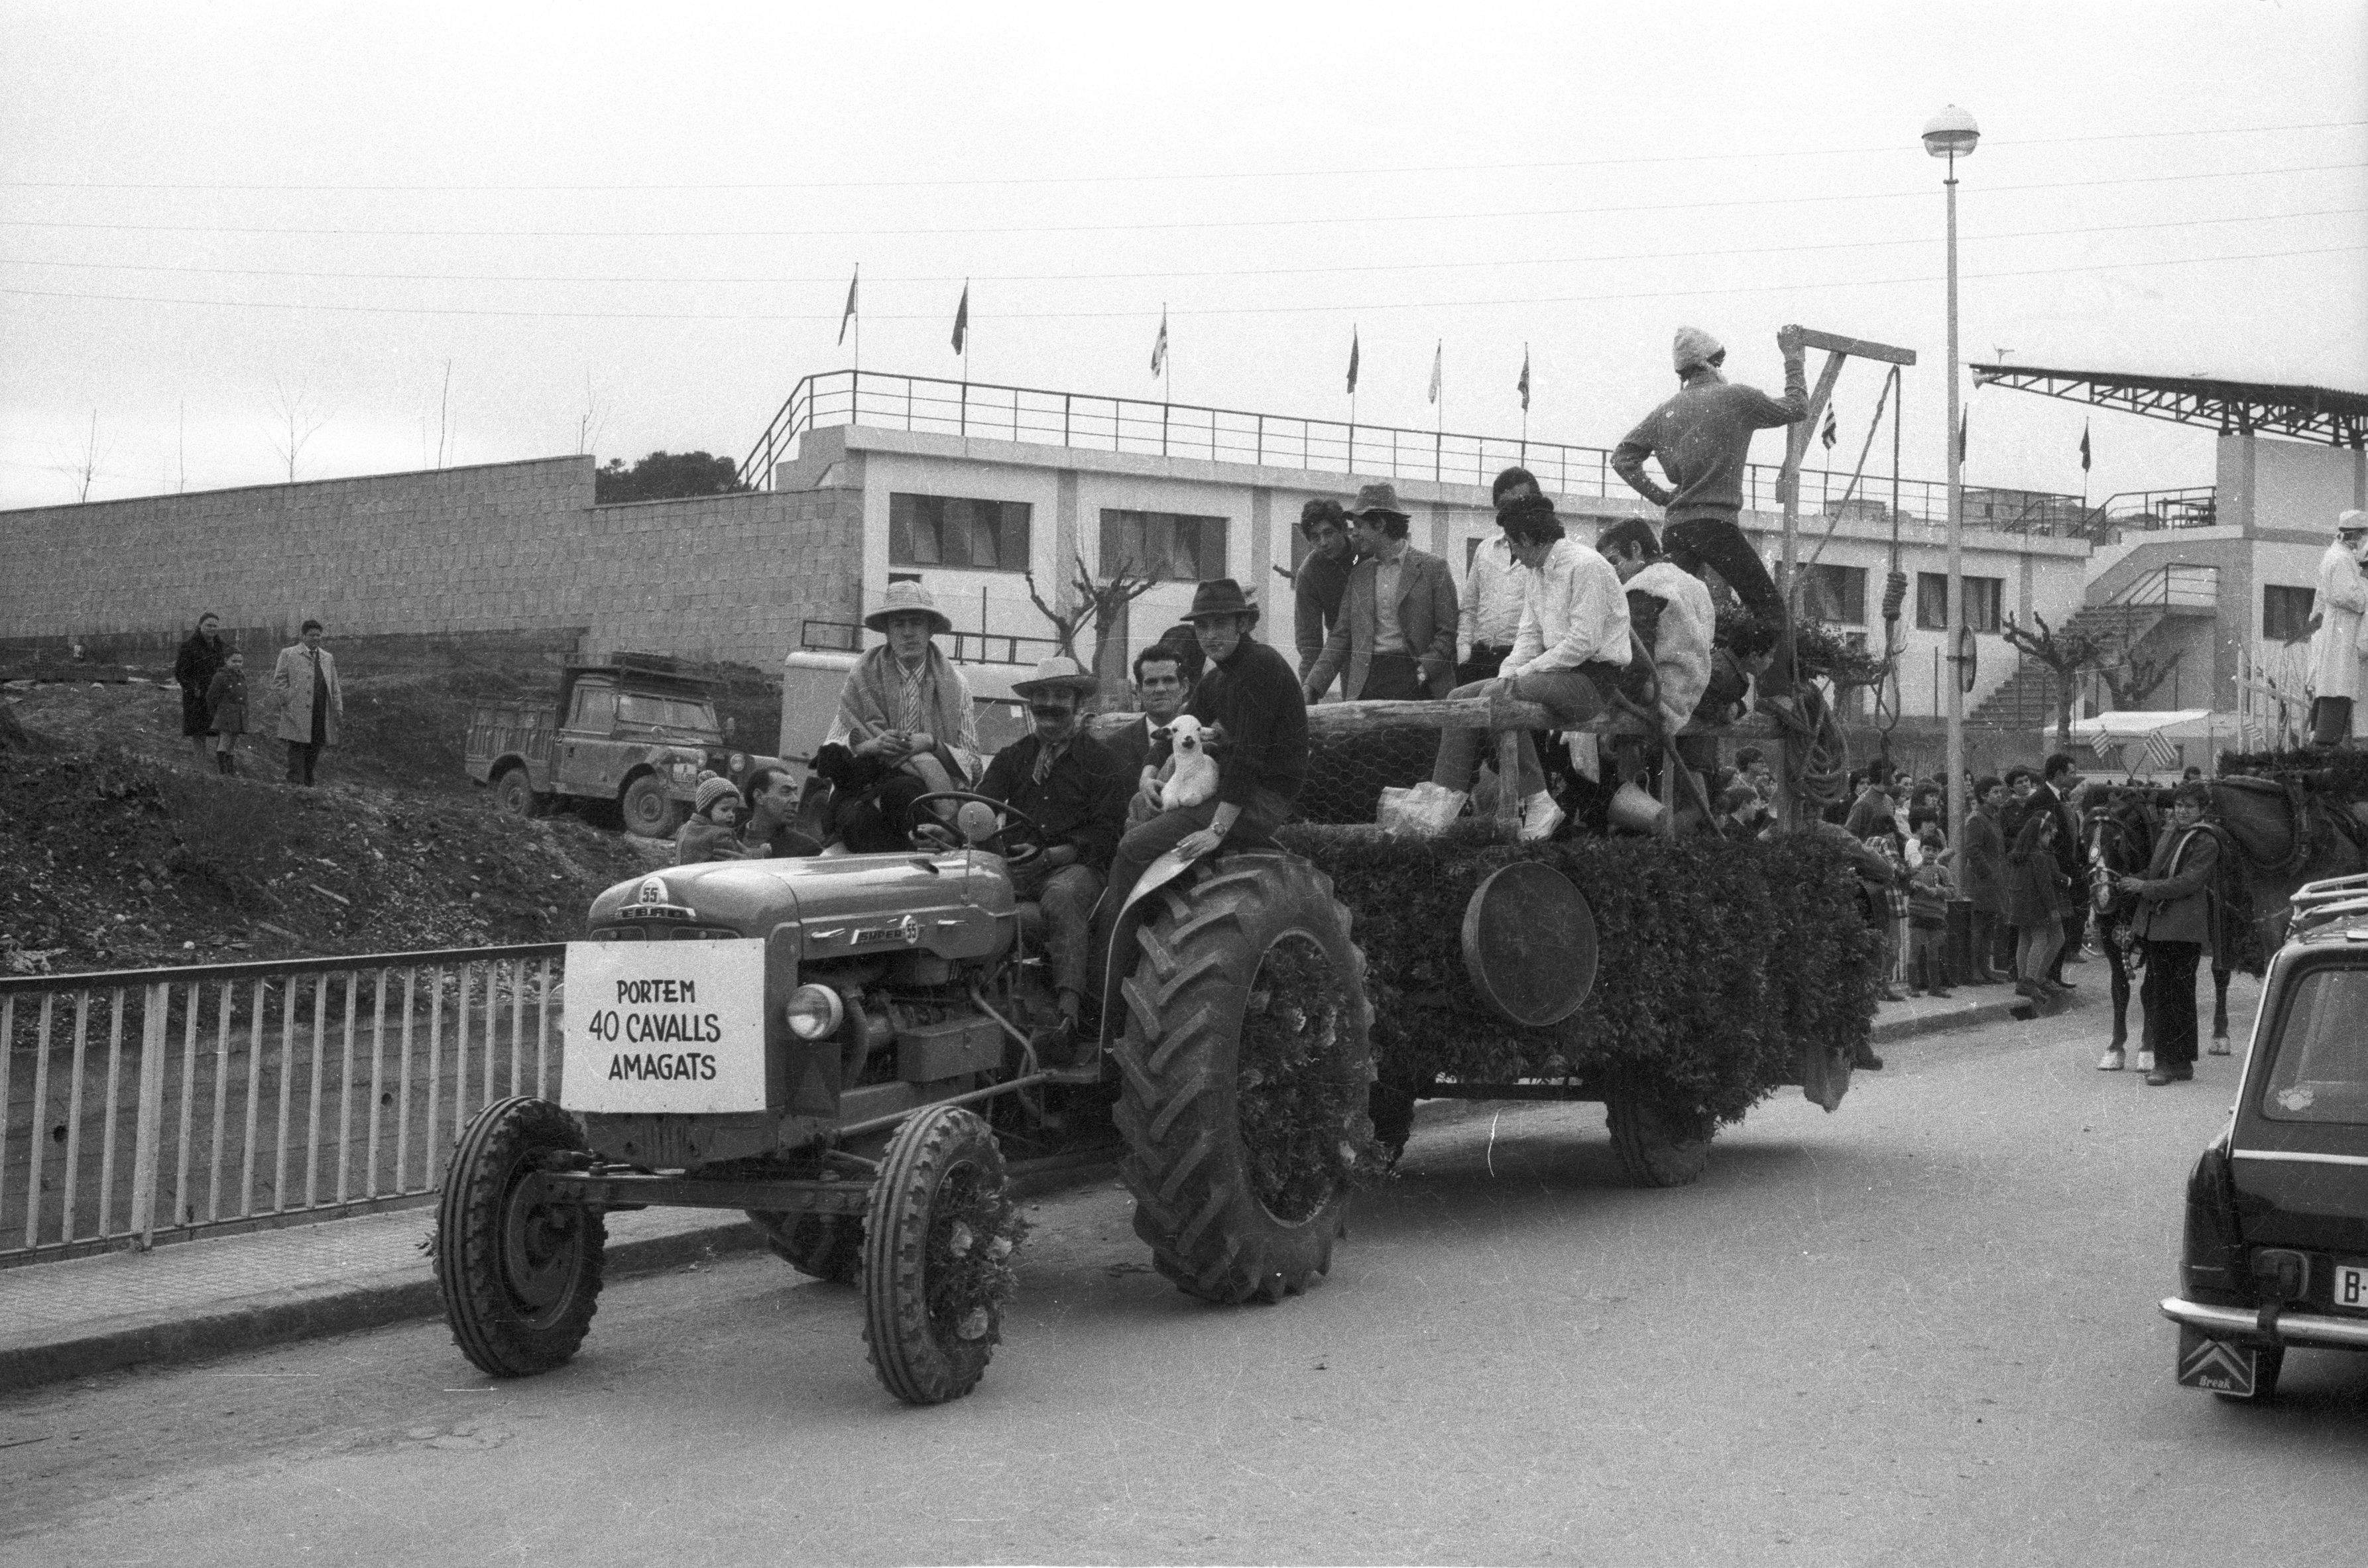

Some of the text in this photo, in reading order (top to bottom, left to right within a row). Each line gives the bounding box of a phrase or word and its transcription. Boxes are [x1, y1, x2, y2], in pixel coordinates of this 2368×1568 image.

[642, 887, 658, 902] 55
[860, 923, 916, 941] SUPER 55
[617, 979, 696, 1004] PORTEM
[589, 1010, 721, 1043] 40 CAVALLS
[609, 1053, 717, 1080] AMAGATS
[2199, 1375, 2230, 1390] Break
